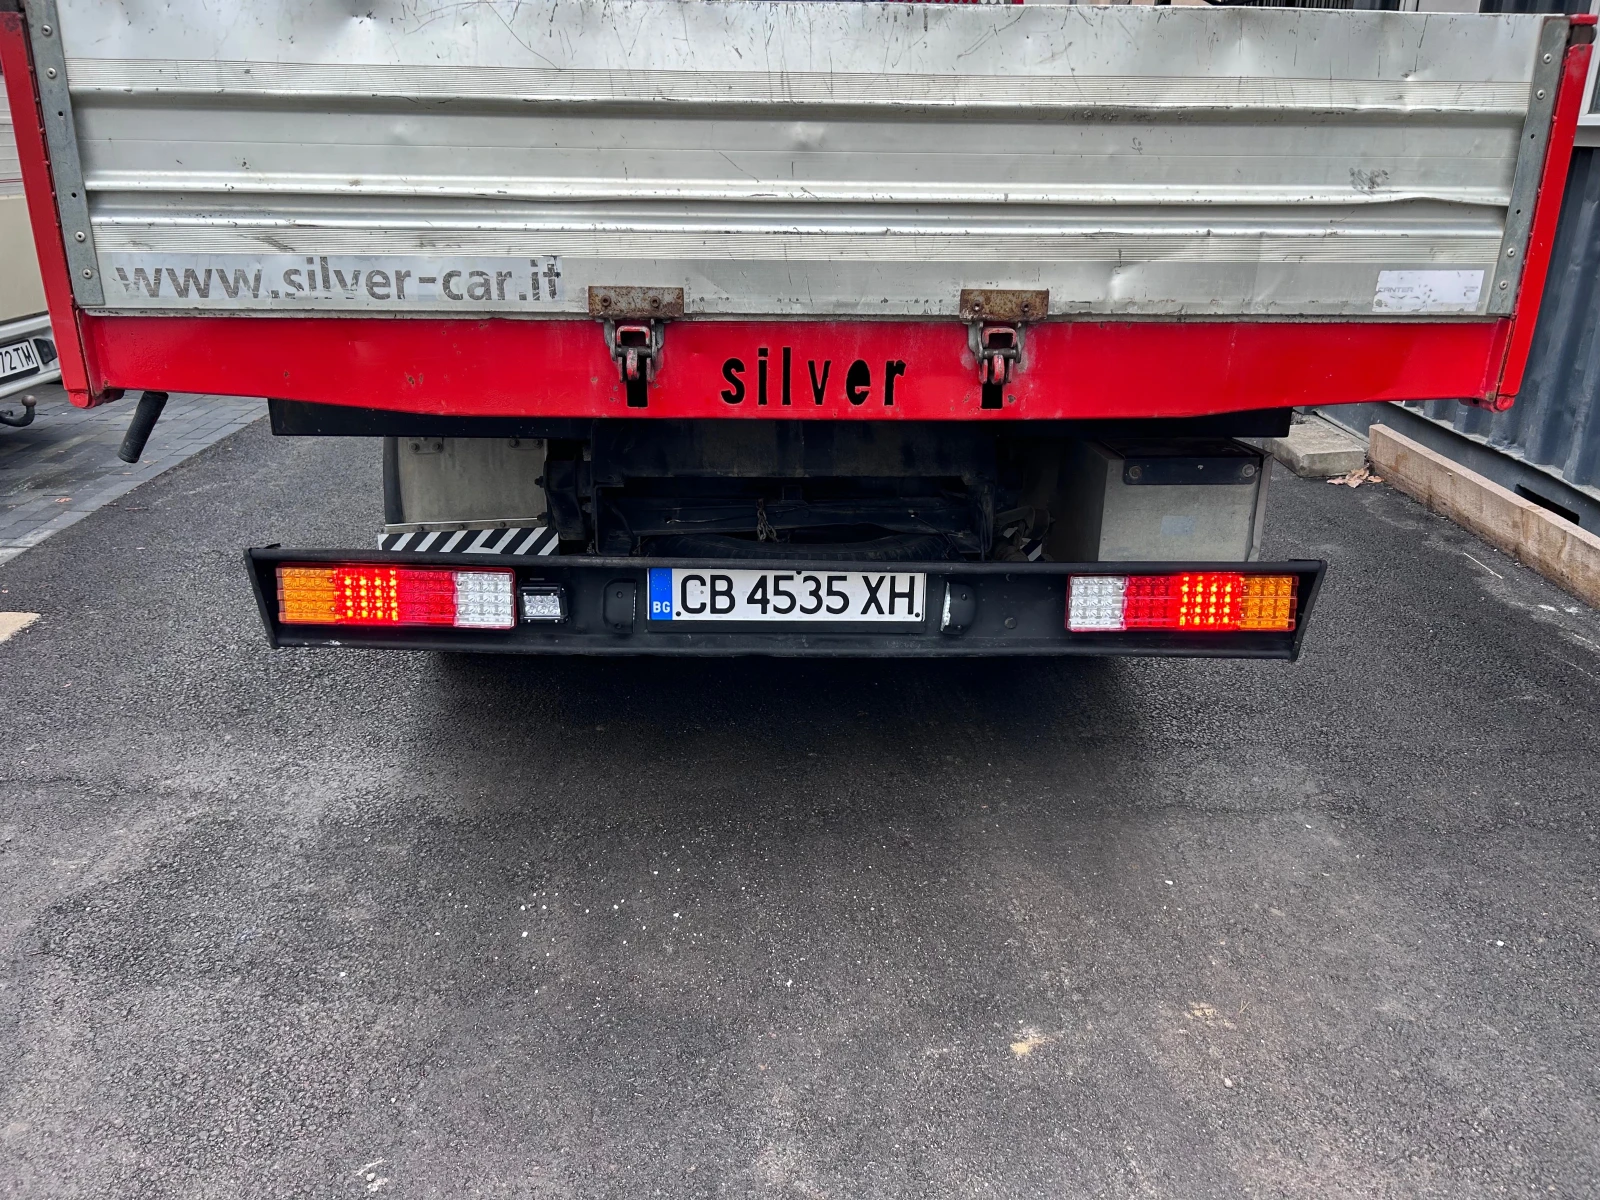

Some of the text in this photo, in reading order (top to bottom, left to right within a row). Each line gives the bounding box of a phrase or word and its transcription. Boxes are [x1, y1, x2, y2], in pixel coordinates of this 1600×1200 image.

[115, 255, 562, 301] www.silver-car.it
[720, 346, 907, 406] silver
[652, 601, 671, 613] BG
[680, 574, 915, 615] CB 4535 XH
